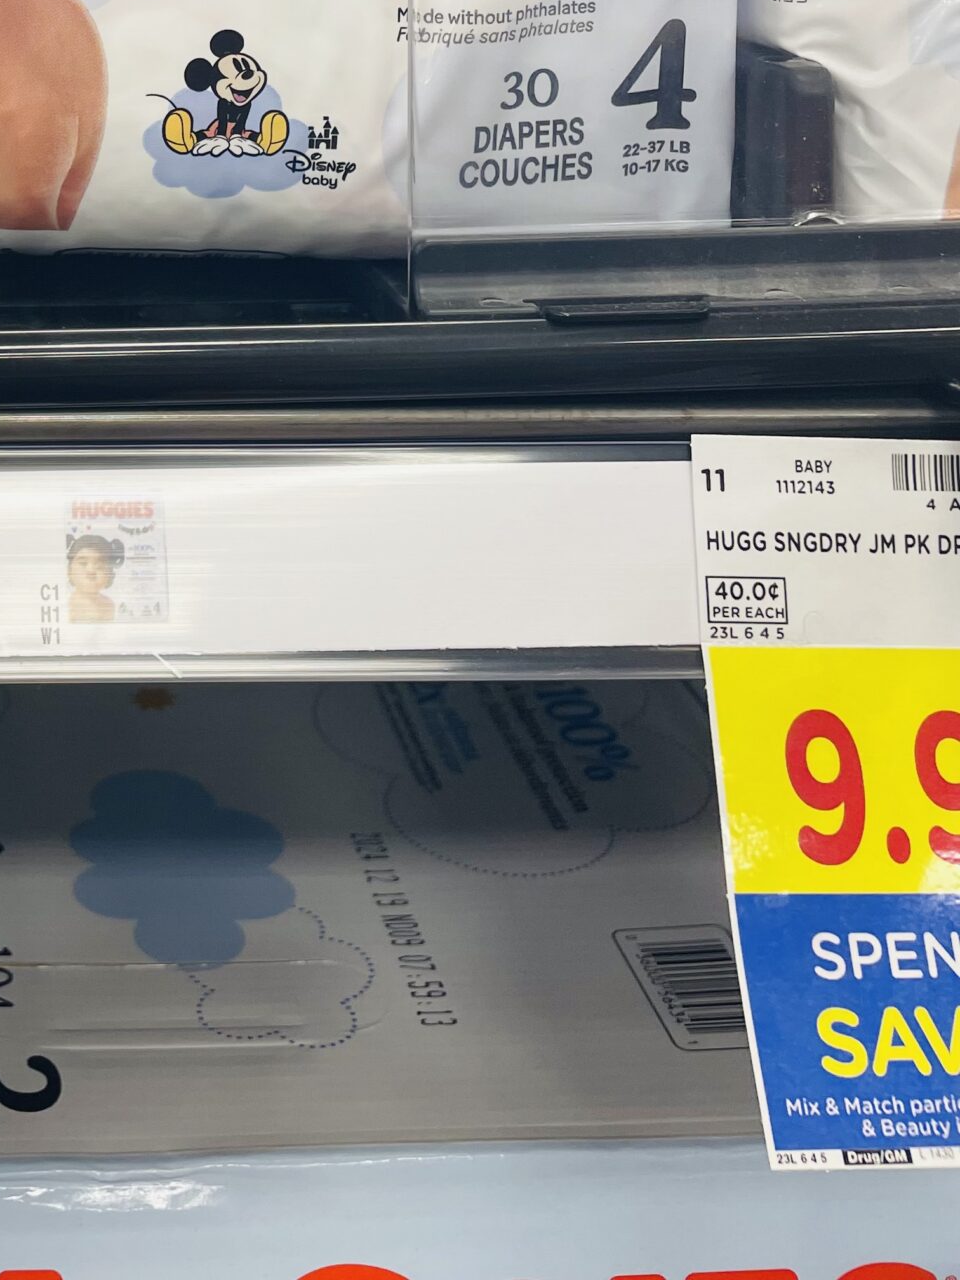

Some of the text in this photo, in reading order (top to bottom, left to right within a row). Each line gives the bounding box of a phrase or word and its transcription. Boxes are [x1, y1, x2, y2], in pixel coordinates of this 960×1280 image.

[448, 0, 596, 25] without phthalates
[479, 19, 594, 44] sans phtalates
[611, 18, 697, 130] 4
[500, 68, 559, 110] 30
[473, 117, 584, 154] DIAPERS
[669, 141, 690, 154] LB
[459, 152, 593, 189] COUCHES
[665, 159, 689, 173] KG
[302, 174, 338, 189] baby
[795, 460, 832, 473] BABY
[701, 469, 725, 492] 11
[776, 480, 835, 494] 1112143
[707, 530, 930, 554] HUGG SNGDRY JM PK
[713, 607, 740, 618] PER
[786, 1096, 904, 1116] Mix Match
[881, 1118, 950, 1139] Beauty
